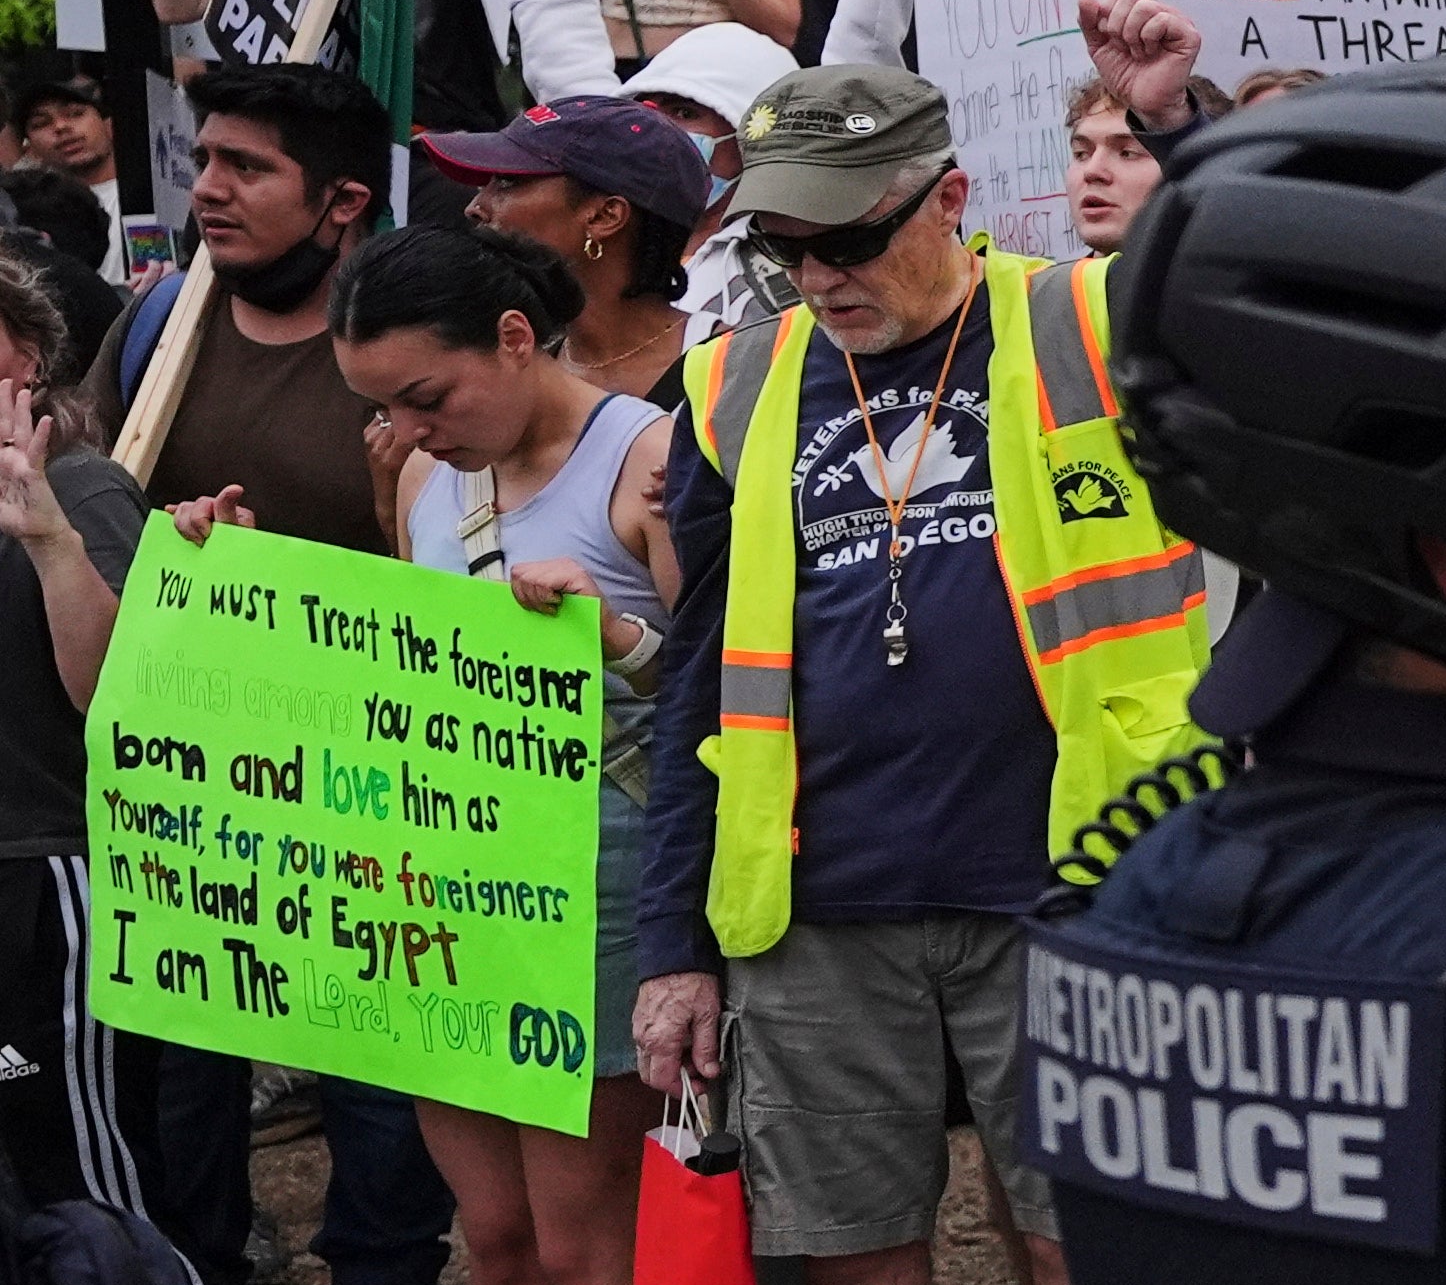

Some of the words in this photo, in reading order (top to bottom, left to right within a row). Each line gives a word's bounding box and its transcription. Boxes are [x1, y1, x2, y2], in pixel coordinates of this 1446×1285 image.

[1240, 17, 1268, 58] A
[1010, 61, 1039, 124] the
[791, 389, 900, 487] VETERANS
[1078, 461, 1102, 471] FOR
[1103, 468, 1133, 501] PEACE
[803, 517, 847, 540] HUGH
[806, 525, 870, 551] CHAPTER
[815, 538, 880, 571] SAN
[157, 568, 192, 610] YOU
[210, 583, 277, 630] MUST
[300, 594, 381, 662] Treat
[391, 612, 438, 675] the
[449, 628, 592, 716] foreigner
[135, 643, 231, 713] living
[243, 680, 353, 737] among
[364, 692, 411, 744] you
[425, 711, 461, 754] as
[473, 715, 598, 782] native-
[113, 721, 206, 782] born
[230, 745, 303, 805] and
[323, 747, 391, 821] love
[402, 760, 457, 832] him
[467, 793, 500, 834] as
[108, 844, 134, 893] in
[140, 859, 183, 910] the
[190, 871, 258, 928] land
[277, 883, 312, 940] of
[214, 812, 265, 867] for
[277, 834, 326, 878] you
[334, 852, 385, 894] were
[396, 851, 569, 924] foreigners
[109, 909, 136, 986] I
[156, 950, 209, 1002] am
[223, 937, 290, 1018] The
[304, 958, 401, 1043] Lord,
[1026, 942, 1411, 1109] METROPOLITAN
[1038, 1056, 1388, 1223] POLICE
